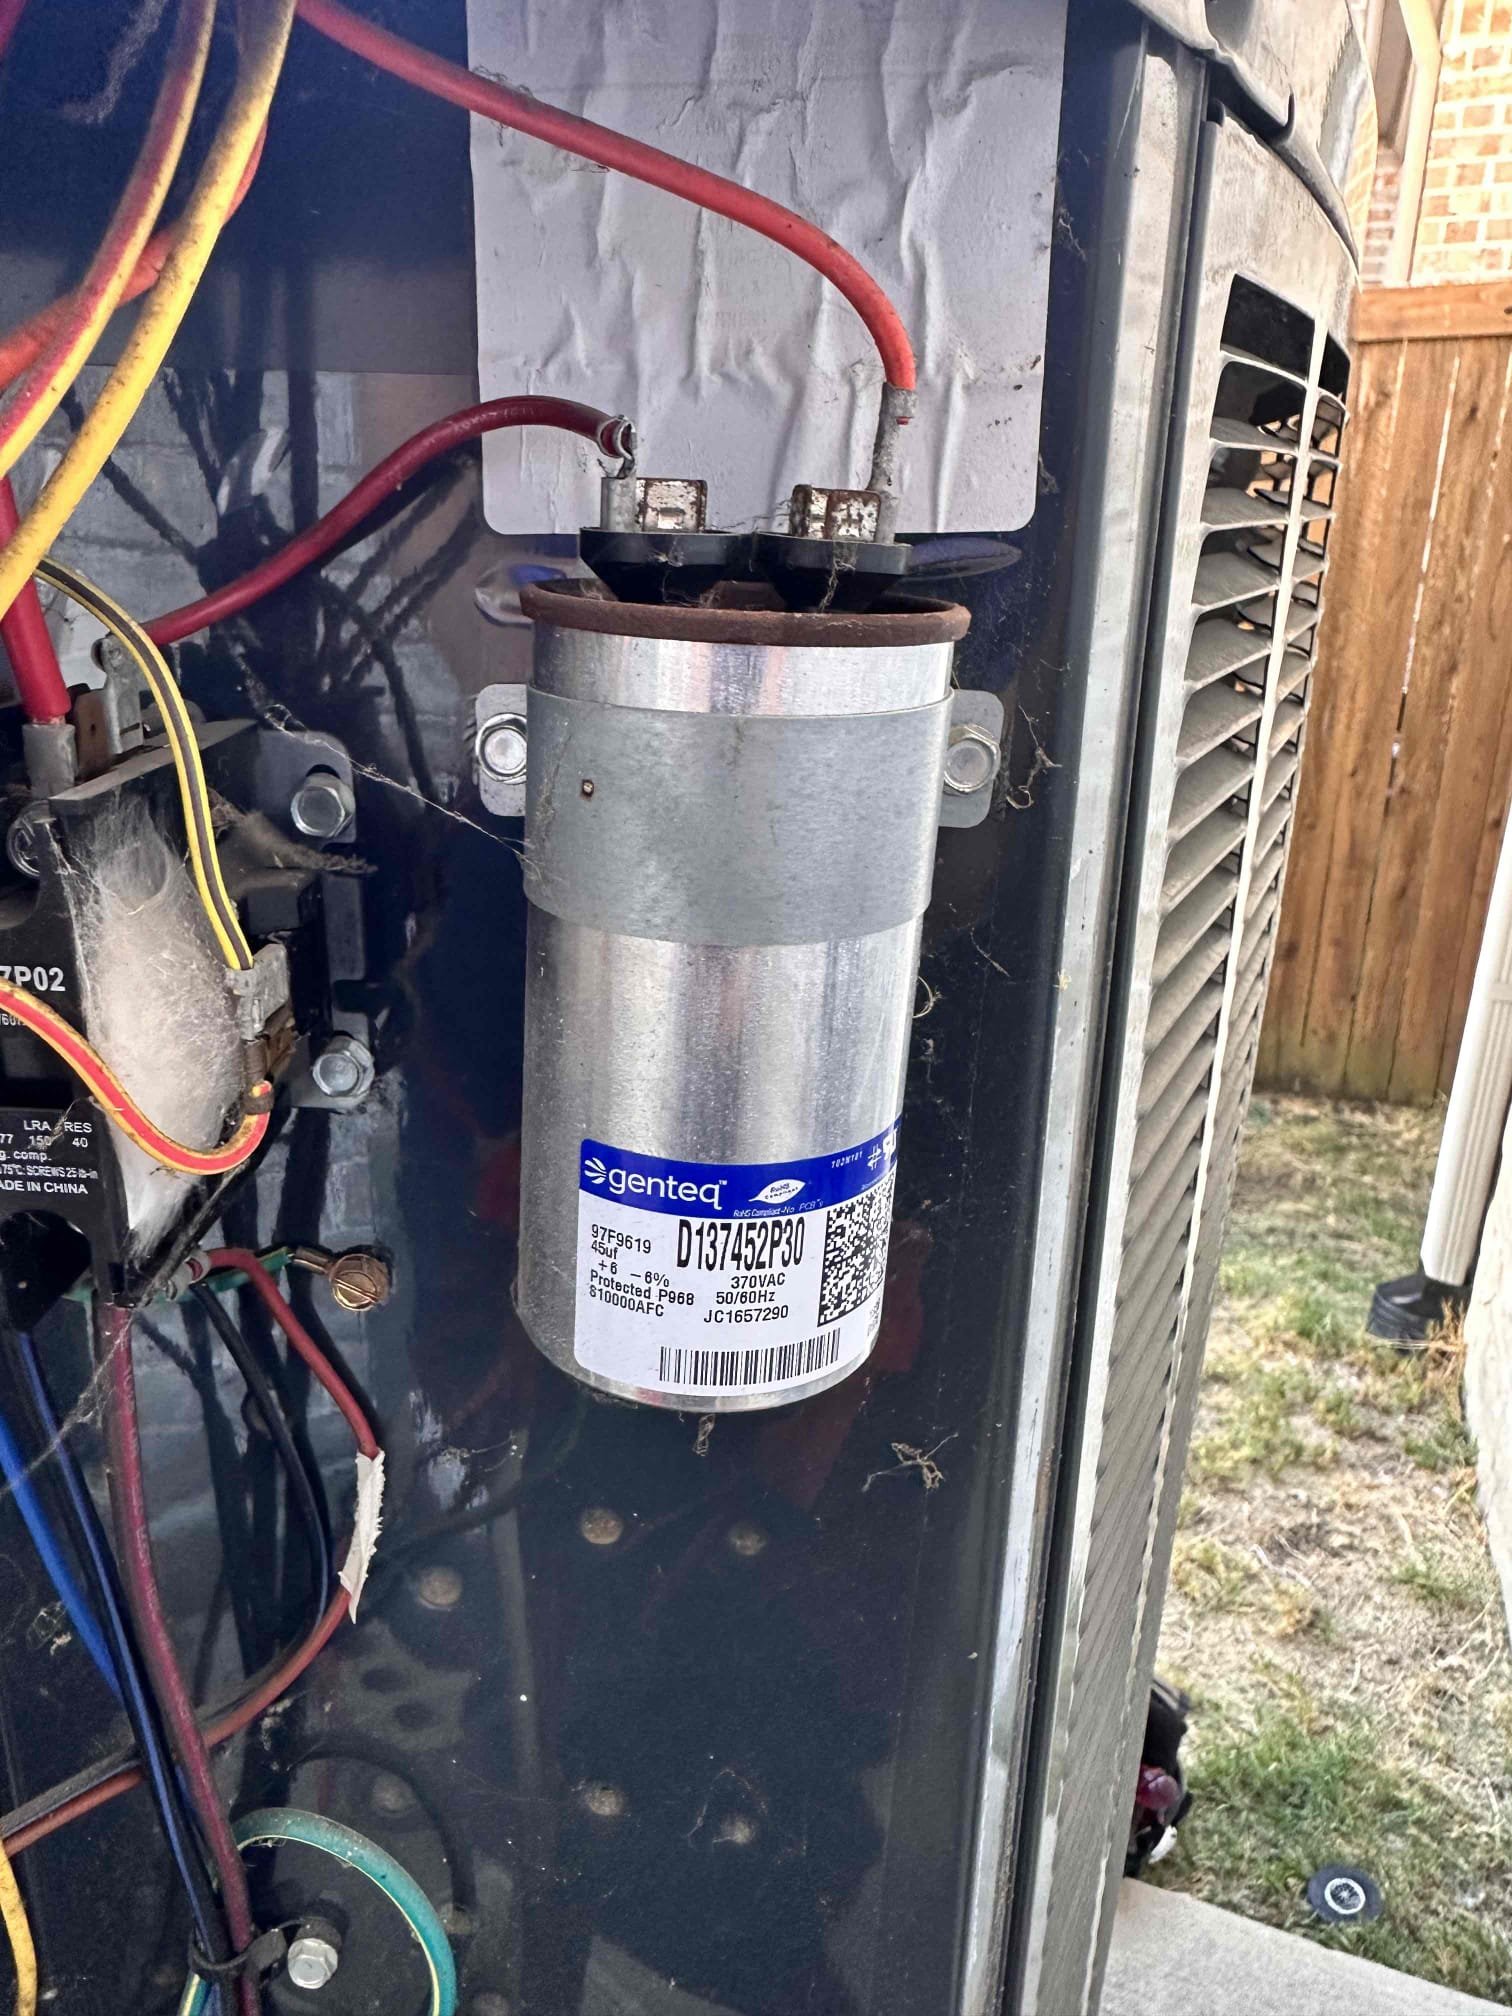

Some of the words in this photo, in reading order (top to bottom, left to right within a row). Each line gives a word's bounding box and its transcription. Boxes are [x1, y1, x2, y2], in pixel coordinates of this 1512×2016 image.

[23, 1120, 52, 1132] LRA
[63, 1121, 93, 1134] RES
[72, 1137, 88, 1148] 40
[13, 1150, 52, 1163] comp.
[26, 1180, 41, 1192] IN
[43, 1181, 89, 1195] CHINA
[608, 1168, 722, 1211] genteq
[591, 1223, 652, 1254] 97F9619
[677, 1216, 805, 1272] D137452P30
[591, 1239, 618, 1260] 45uf
[590, 1268, 652, 1300] Protected
[658, 1288, 695, 1306] P968
[730, 1272, 786, 1289] 370VAC
[716, 1289, 776, 1305] 50/60Hz
[703, 1304, 789, 1324] JC1657290
